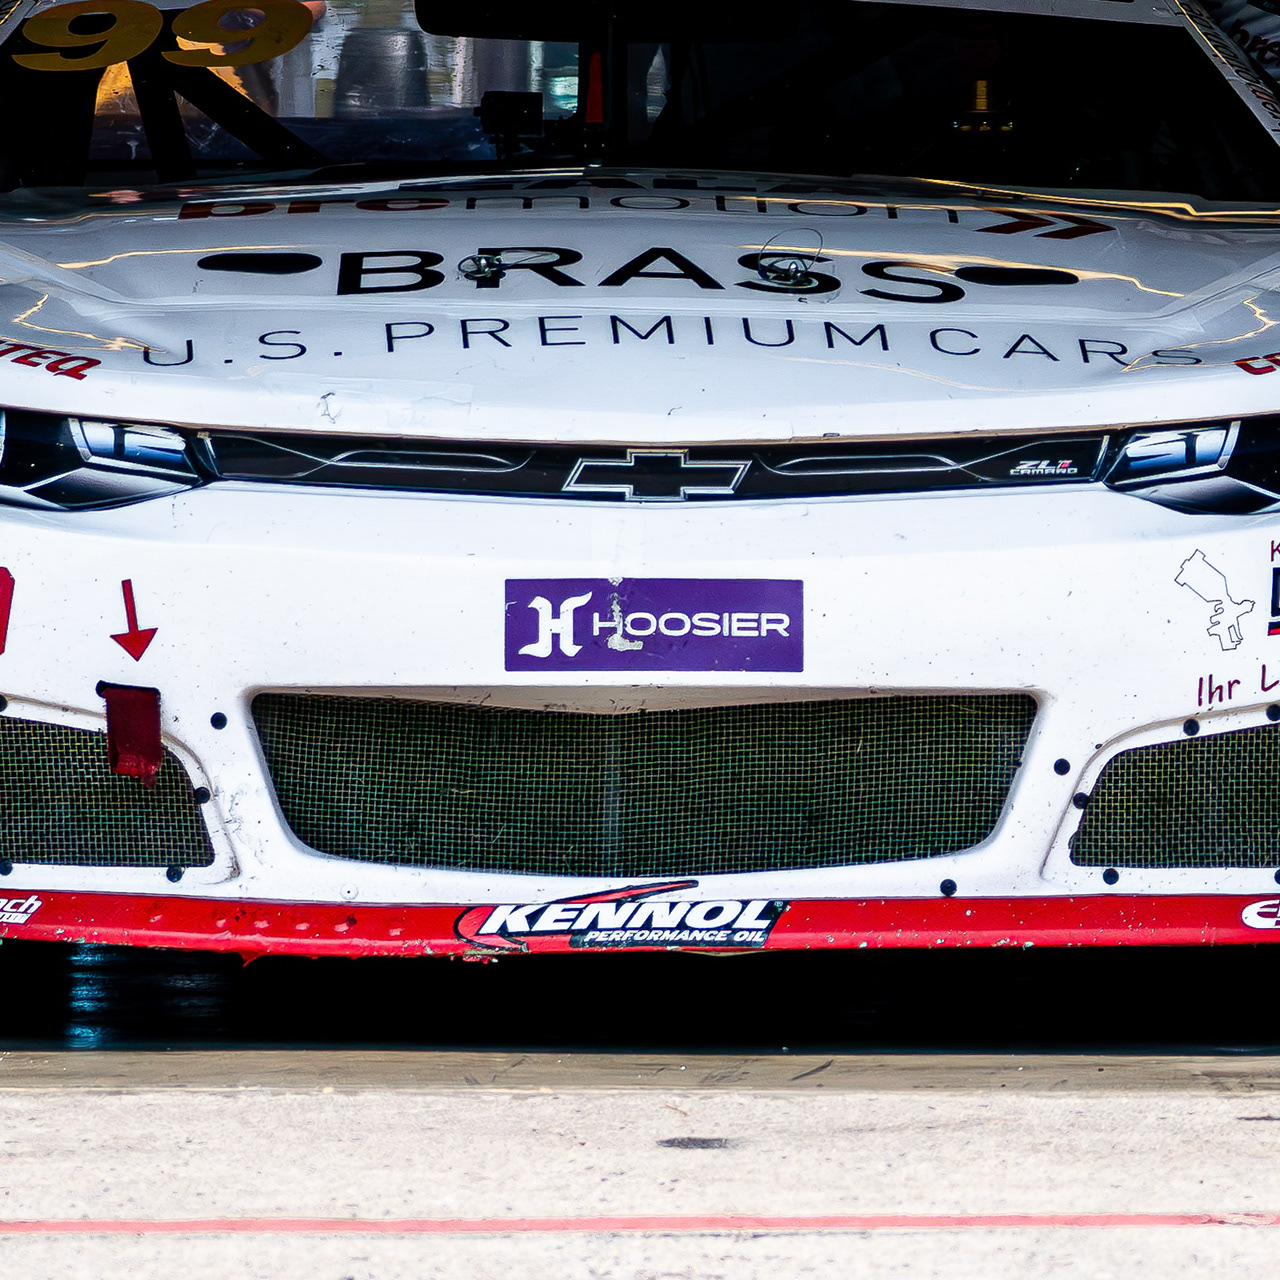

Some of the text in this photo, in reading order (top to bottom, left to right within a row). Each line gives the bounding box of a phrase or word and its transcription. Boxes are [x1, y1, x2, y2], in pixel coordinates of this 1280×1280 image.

[337, 246, 966, 304] BRASS
[143, 315, 1203, 368] U.S. PREMIUM CARS
[1009, 468, 1078, 476] CAMARO
[592, 611, 791, 638] HOOSIER
[1196, 673, 1242, 707] Ihr
[477, 900, 774, 934] KENNOL
[583, 928, 766, 944] PERFORMANCE OIL
